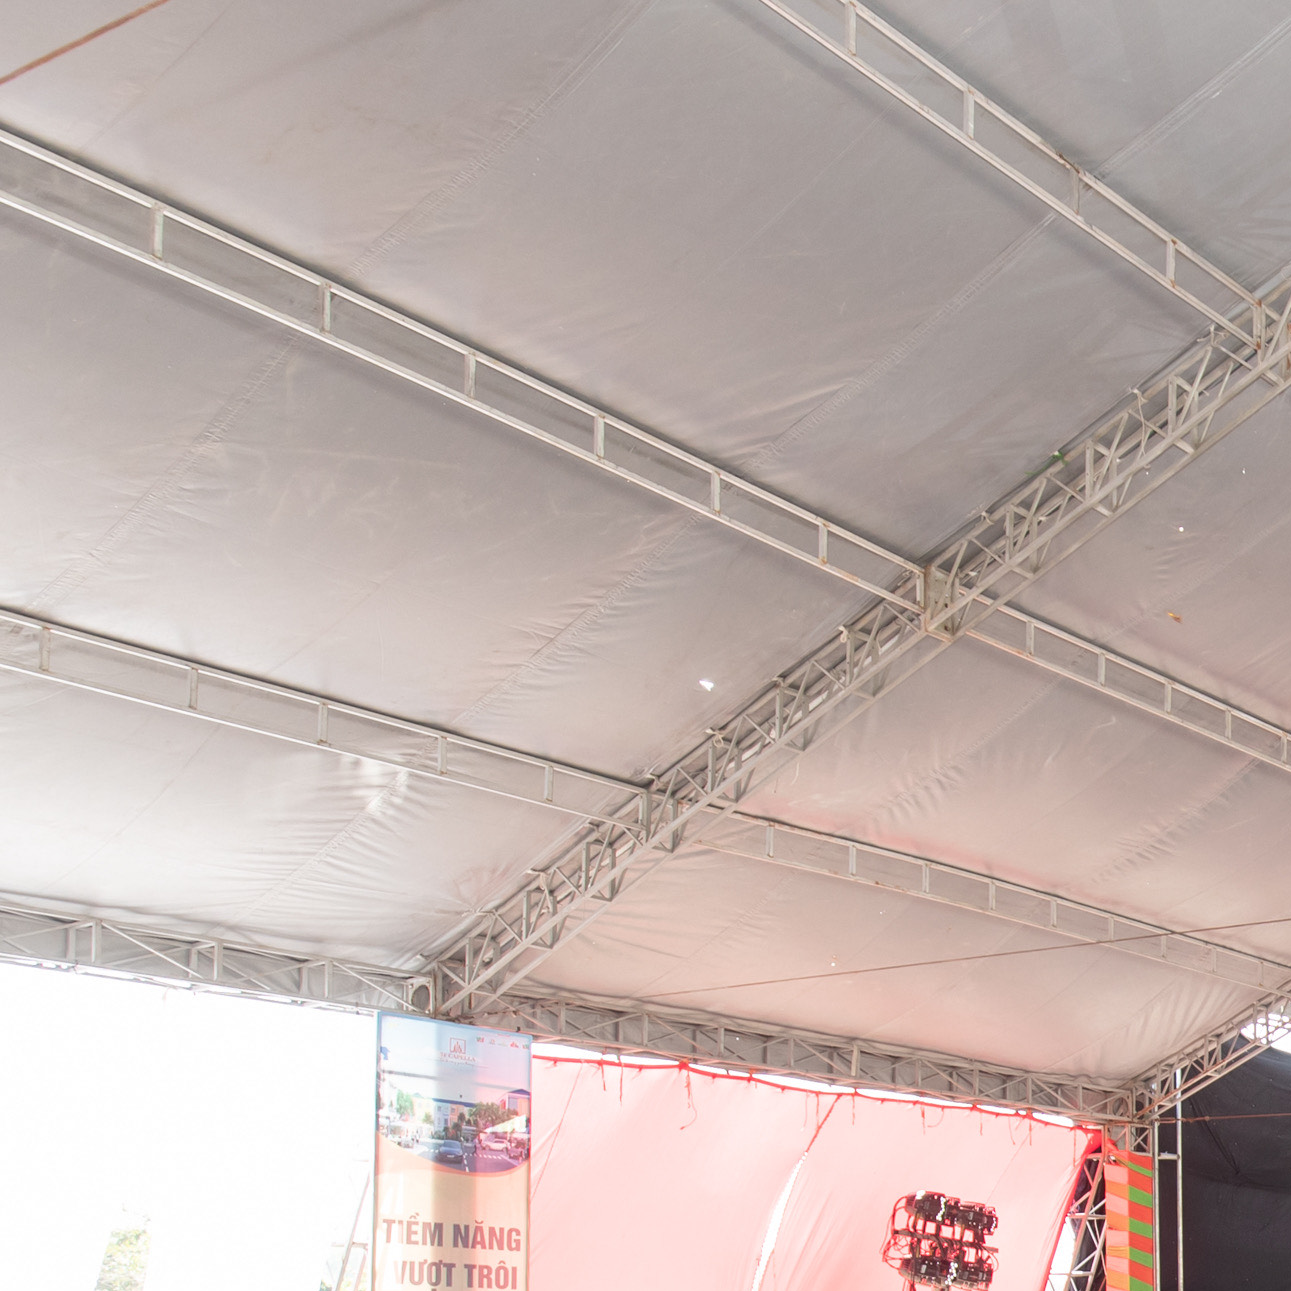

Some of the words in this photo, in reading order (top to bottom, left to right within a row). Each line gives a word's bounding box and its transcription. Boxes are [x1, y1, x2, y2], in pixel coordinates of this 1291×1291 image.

[382, 1213, 444, 1247] TIỀM
[452, 1220, 521, 1251] NĂNG
[394, 1259, 456, 1291] VƯỢT
